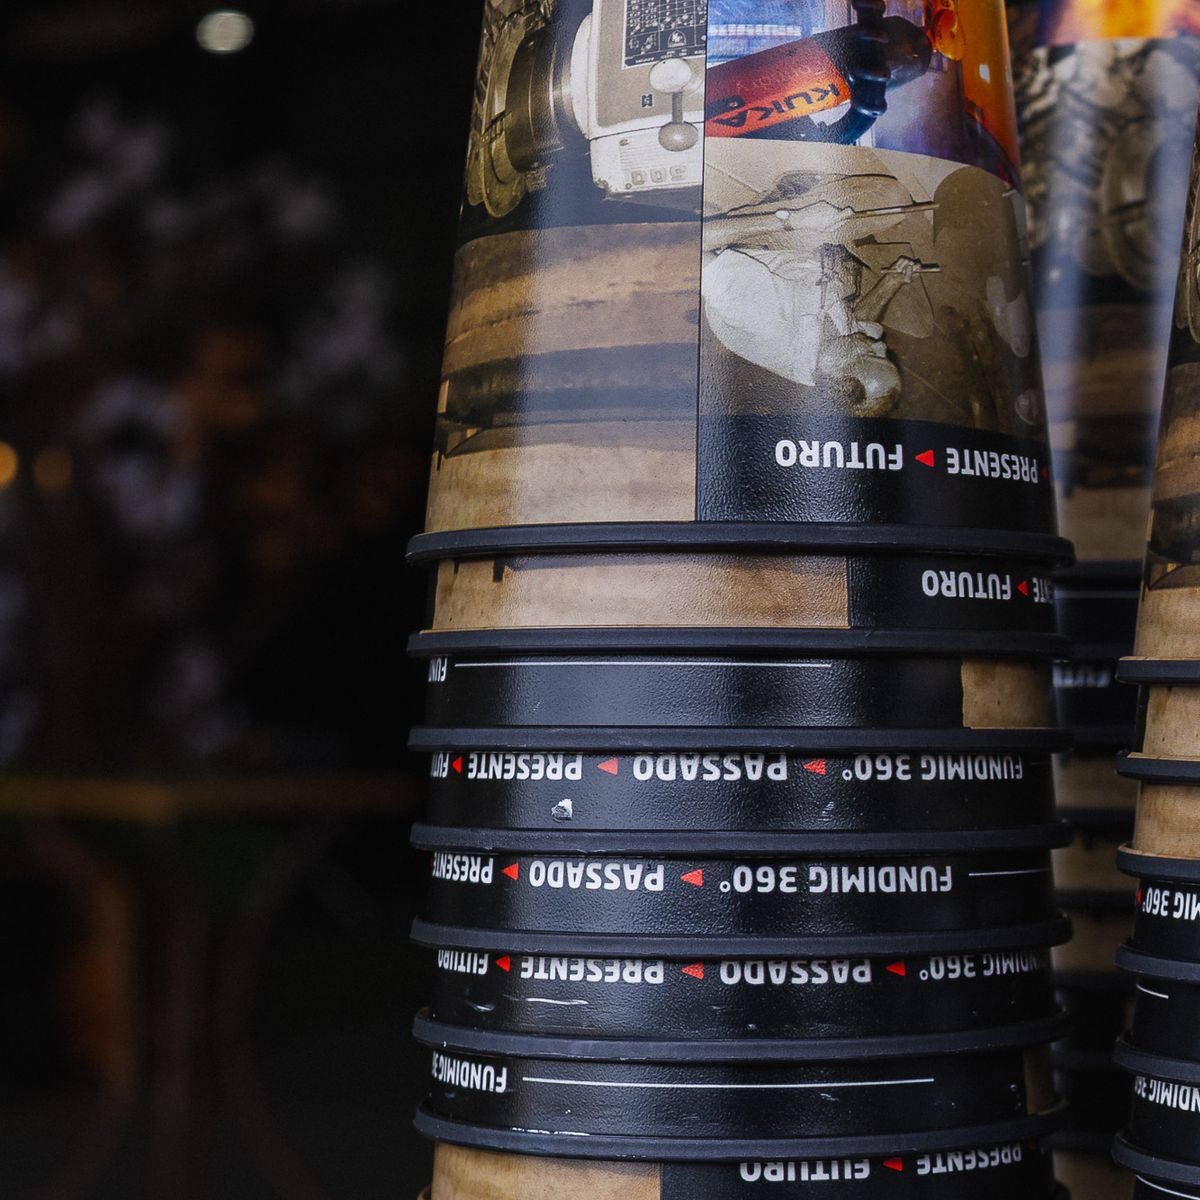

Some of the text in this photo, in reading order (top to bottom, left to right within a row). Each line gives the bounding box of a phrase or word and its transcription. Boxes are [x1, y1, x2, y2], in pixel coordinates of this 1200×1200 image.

[713, 84, 840, 127] KUKA
[775, 439, 1039, 477] PRESENTE FUTURO
[922, 570, 1011, 600] FUTURO
[468, 755, 582, 780] PRESENTE
[630, 756, 787, 784] PASSADO
[842, 758, 911, 781] 360°
[921, 756, 1022, 780] FUNDIMIG
[433, 854, 952, 893] FUNDIMIG 360° PASSADO PRESENTE
[1142, 888, 1171, 917] 360°
[438, 950, 488, 975] FUTURO
[521, 957, 664, 984] PRESENTE
[720, 962, 871, 985] PASSADO
[920, 959, 975, 980] 360°
[438, 1052, 508, 1093] FUNDIMIG
